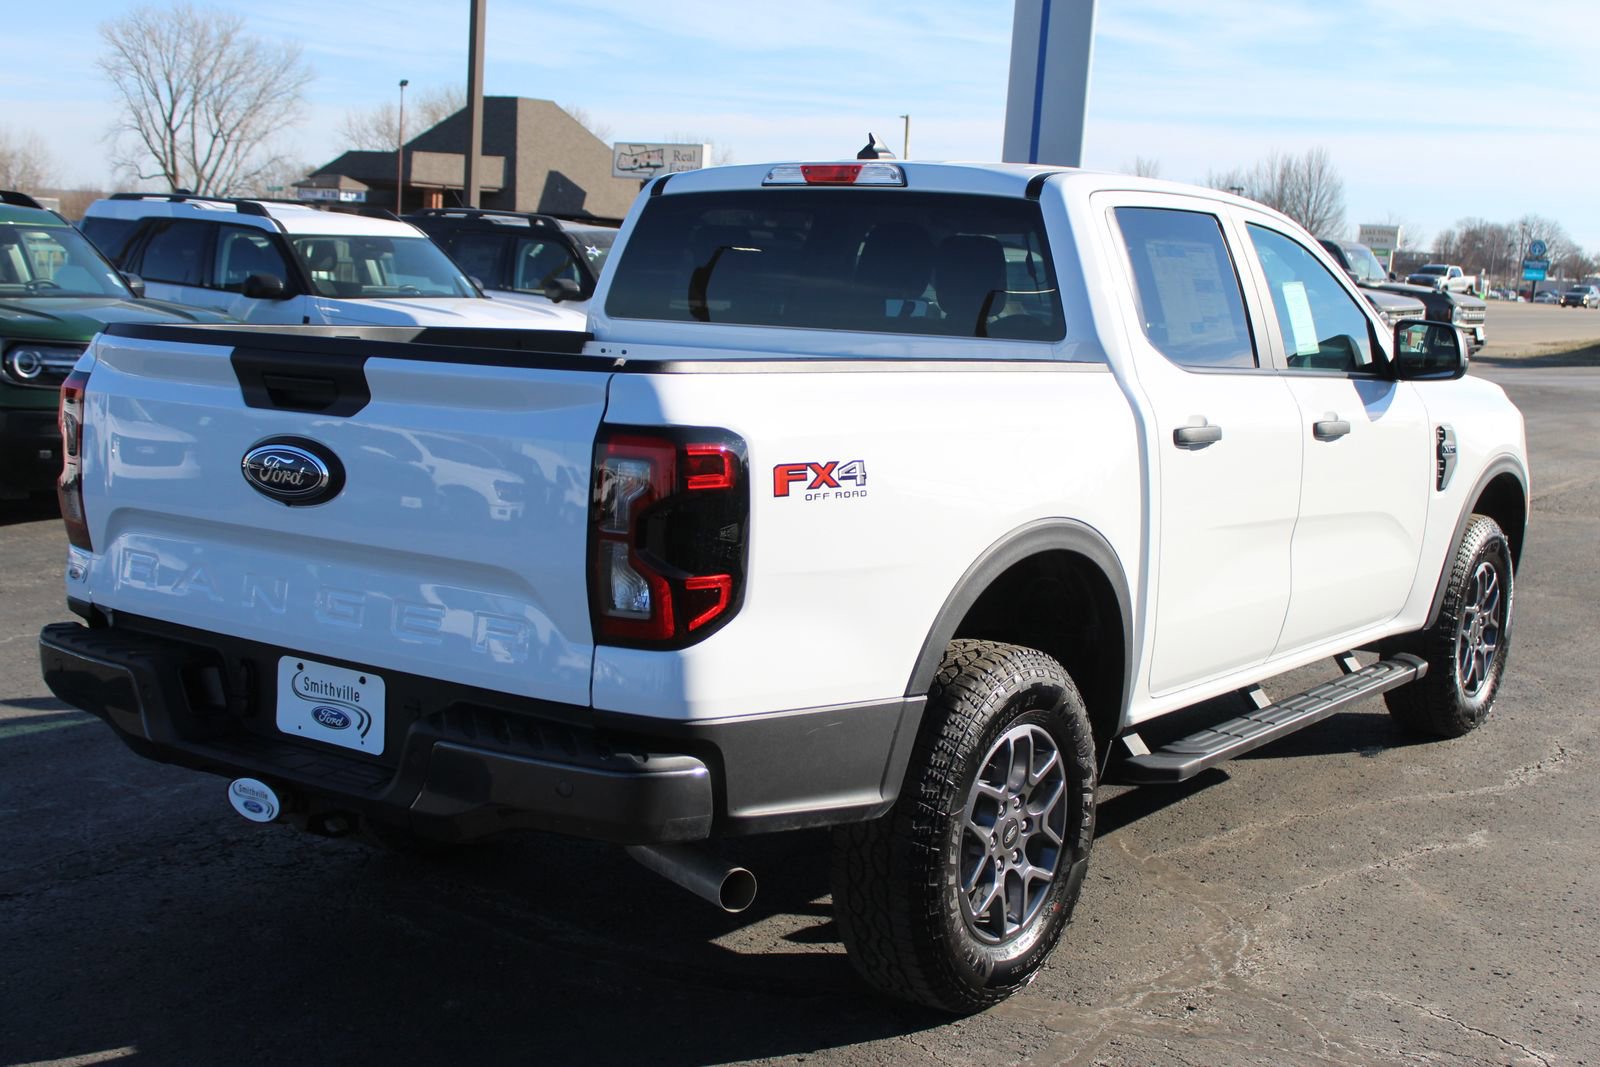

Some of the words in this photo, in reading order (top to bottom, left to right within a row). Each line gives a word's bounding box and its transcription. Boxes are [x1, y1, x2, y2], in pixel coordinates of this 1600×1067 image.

[673, 149, 696, 162] Real
[259, 455, 304, 486] Ford
[773, 459, 867, 498] FX4
[805, 493, 830, 501] OFF
[835, 490, 867, 500] ROAD
[117, 547, 531, 665] RANGER
[304, 676, 360, 702] Smithville
[318, 708, 345, 727] Ford
